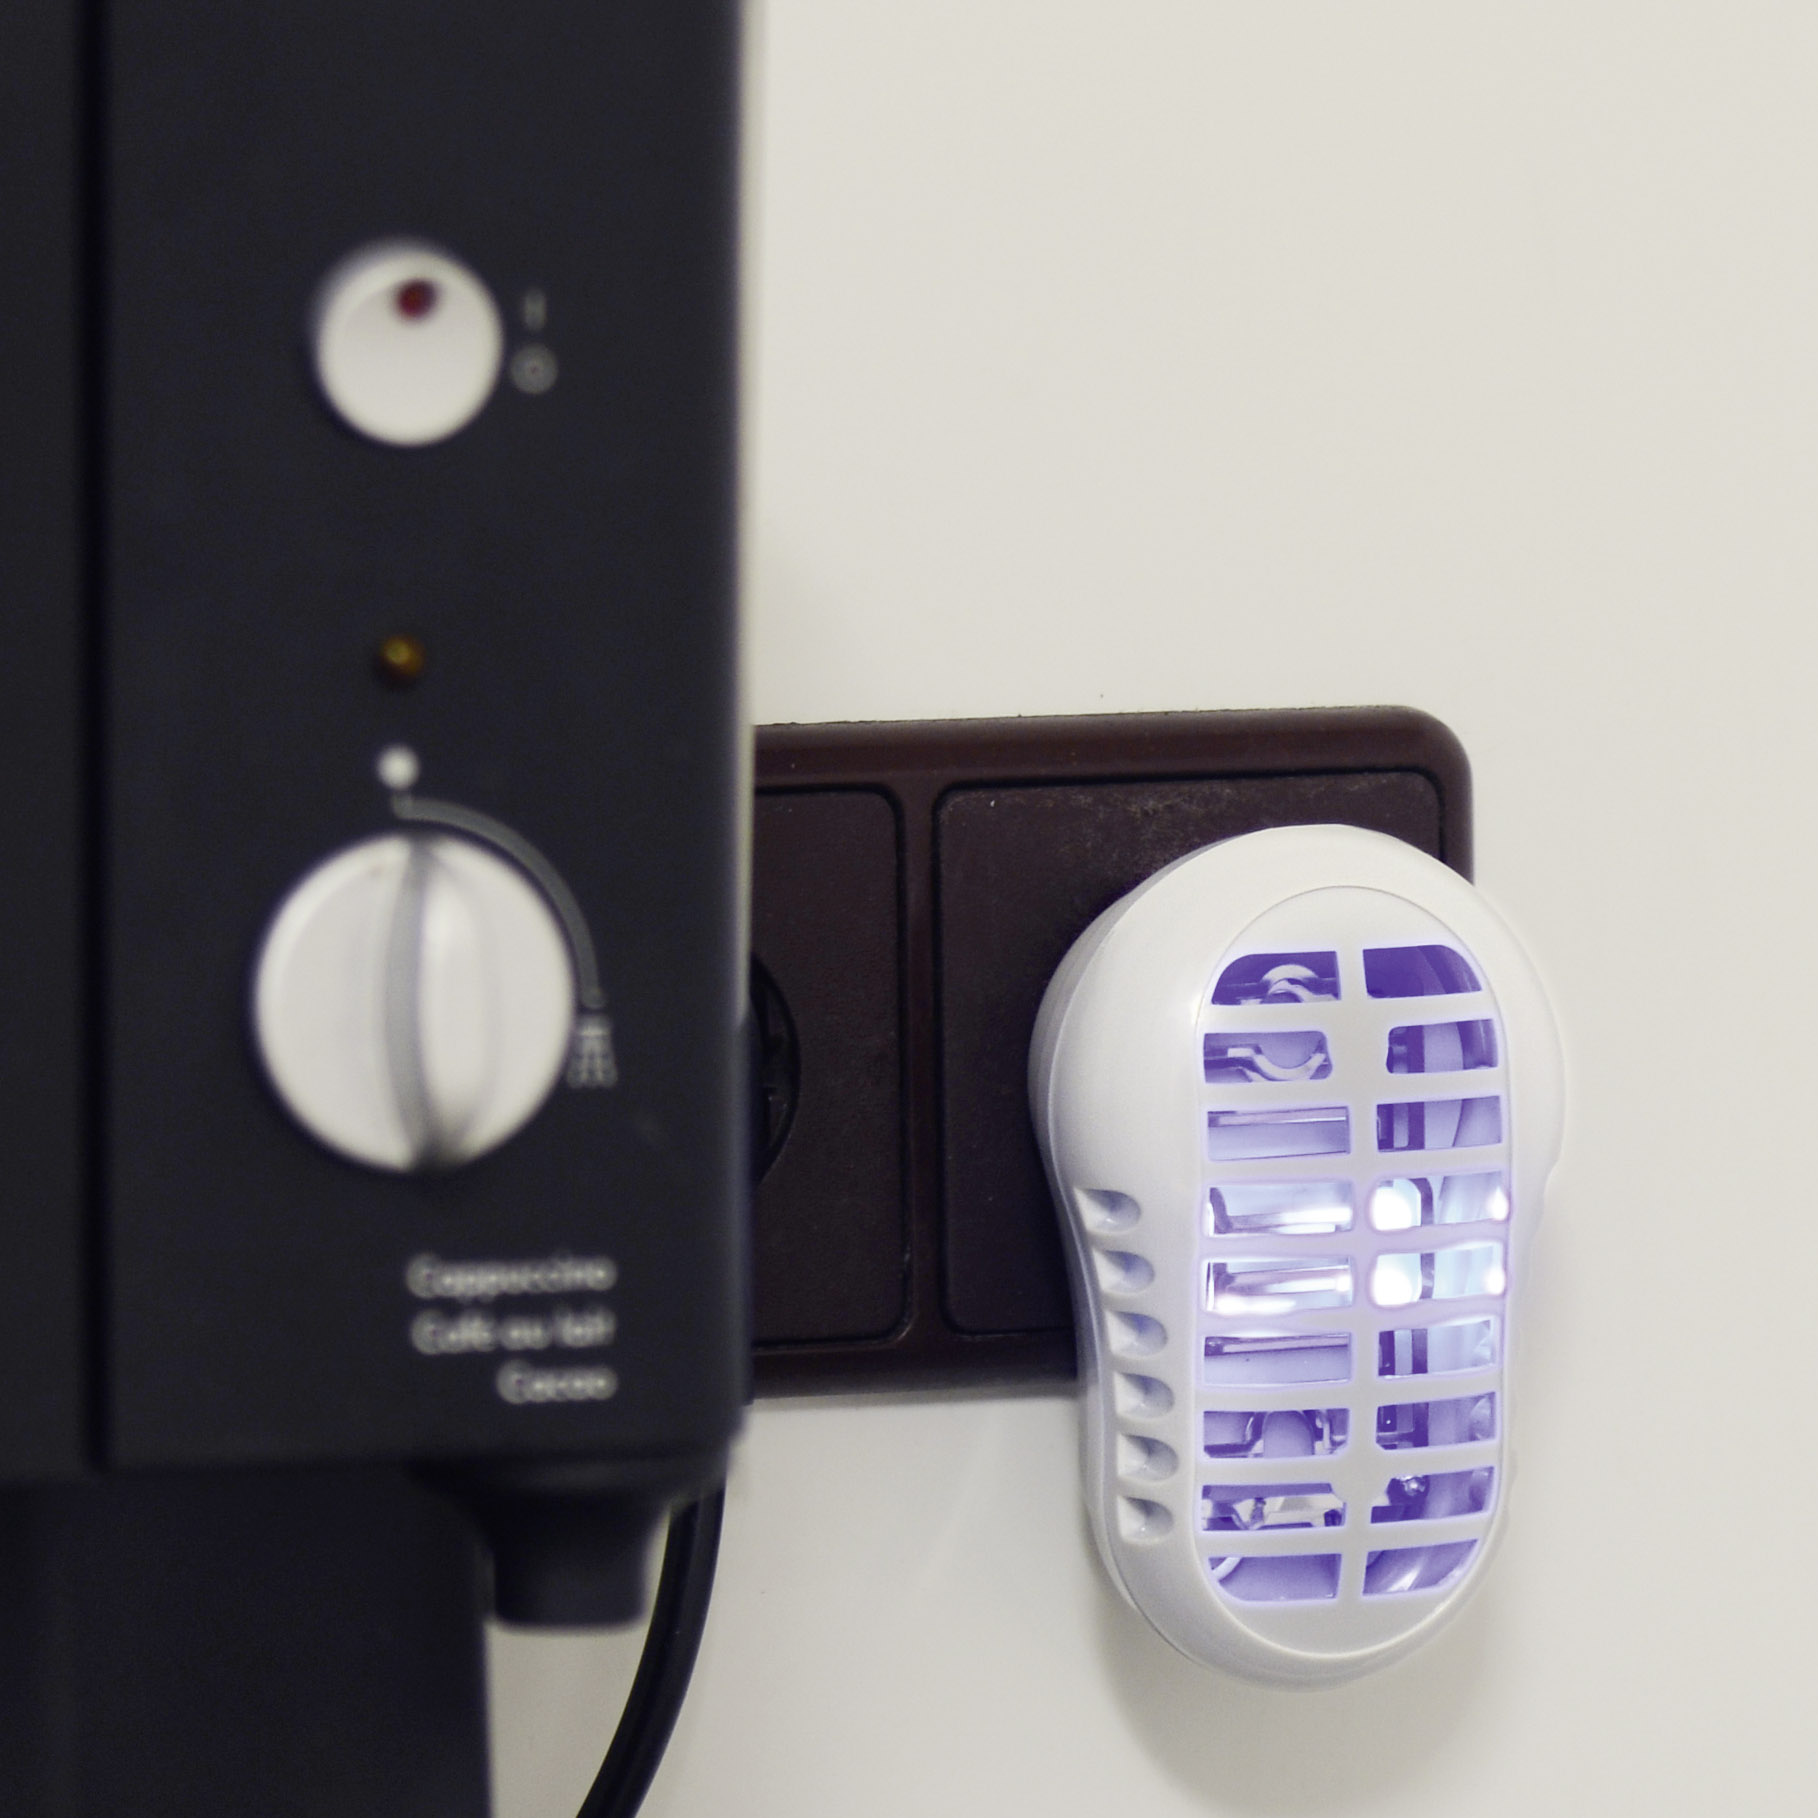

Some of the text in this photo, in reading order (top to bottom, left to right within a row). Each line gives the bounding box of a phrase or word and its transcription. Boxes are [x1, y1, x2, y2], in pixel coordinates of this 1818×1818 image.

[406, 1255, 617, 1302] Cappuccino
[501, 1318, 549, 1350] au
[553, 1304, 616, 1348] lait
[496, 1360, 617, 1404] Cacao
